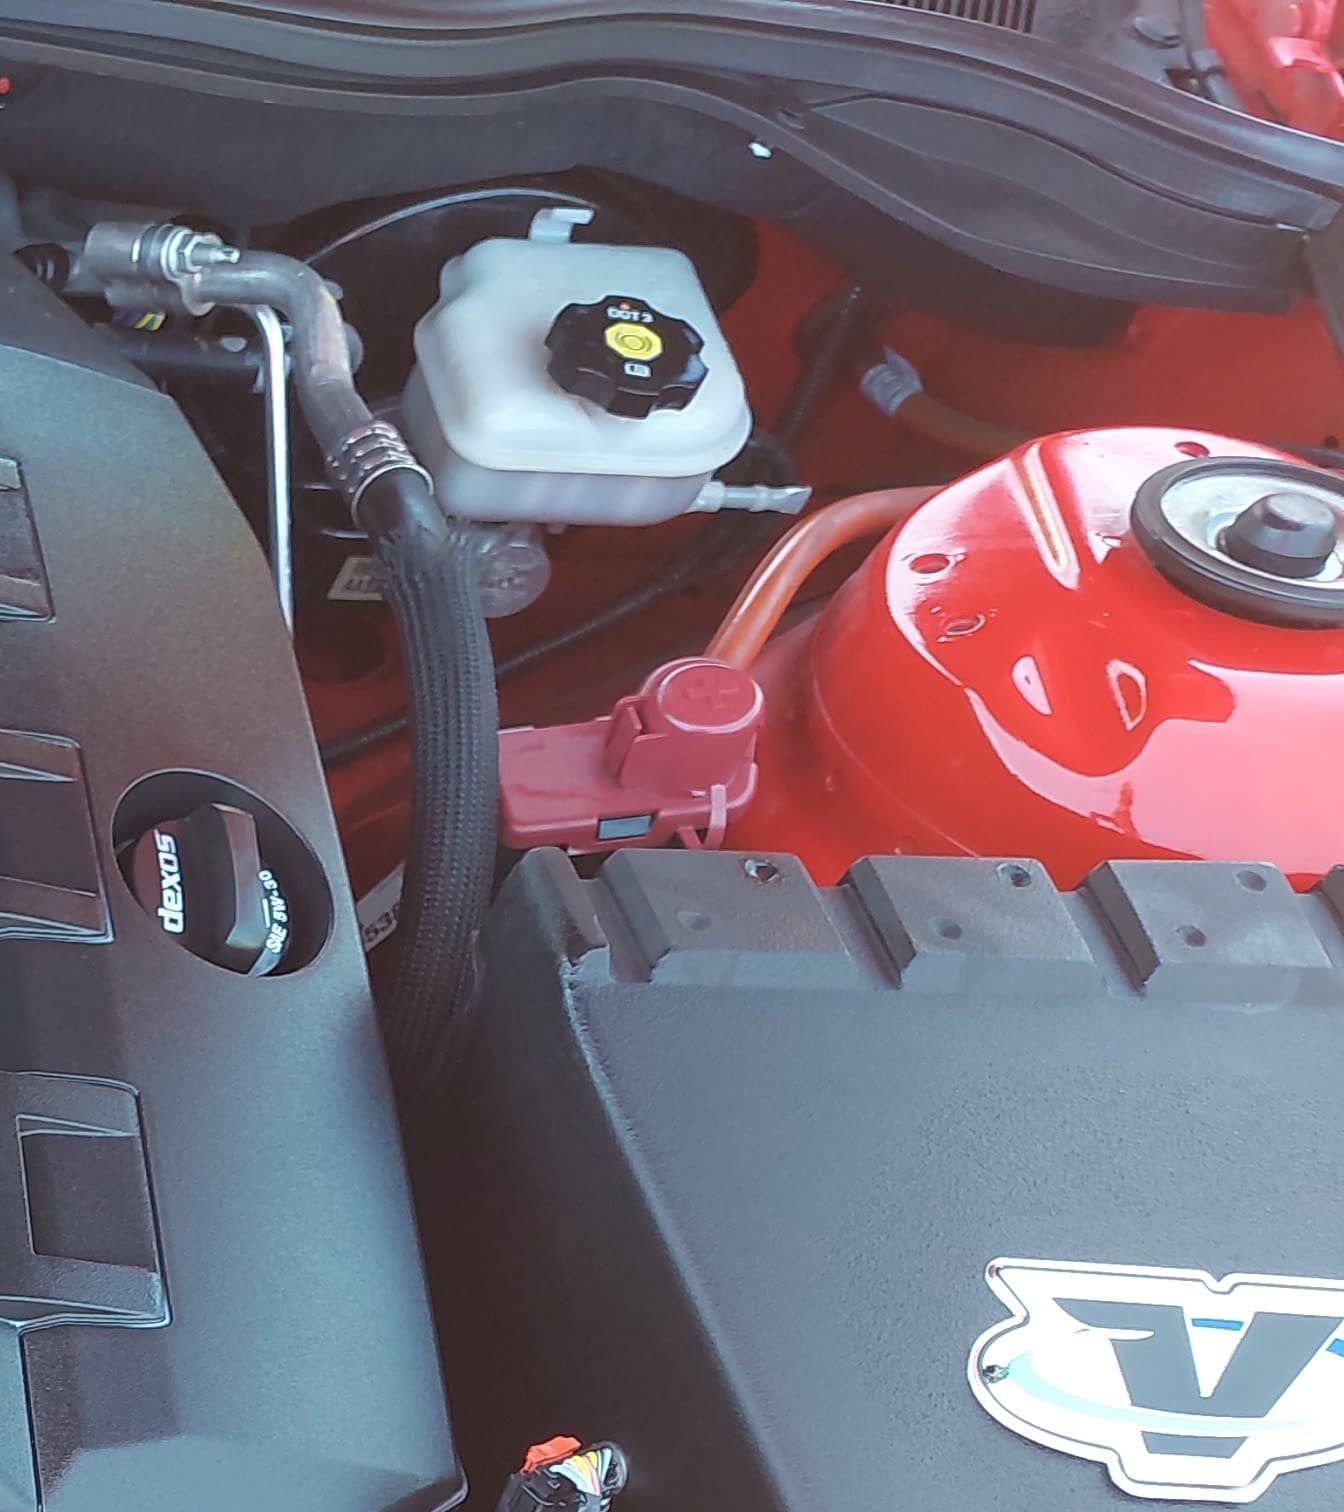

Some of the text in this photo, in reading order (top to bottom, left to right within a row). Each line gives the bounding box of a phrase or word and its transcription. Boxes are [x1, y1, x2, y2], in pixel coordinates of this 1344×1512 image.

[607, 306, 640, 321] DOT
[154, 829, 184, 933] dexos
[266, 925, 287, 954] SAE
